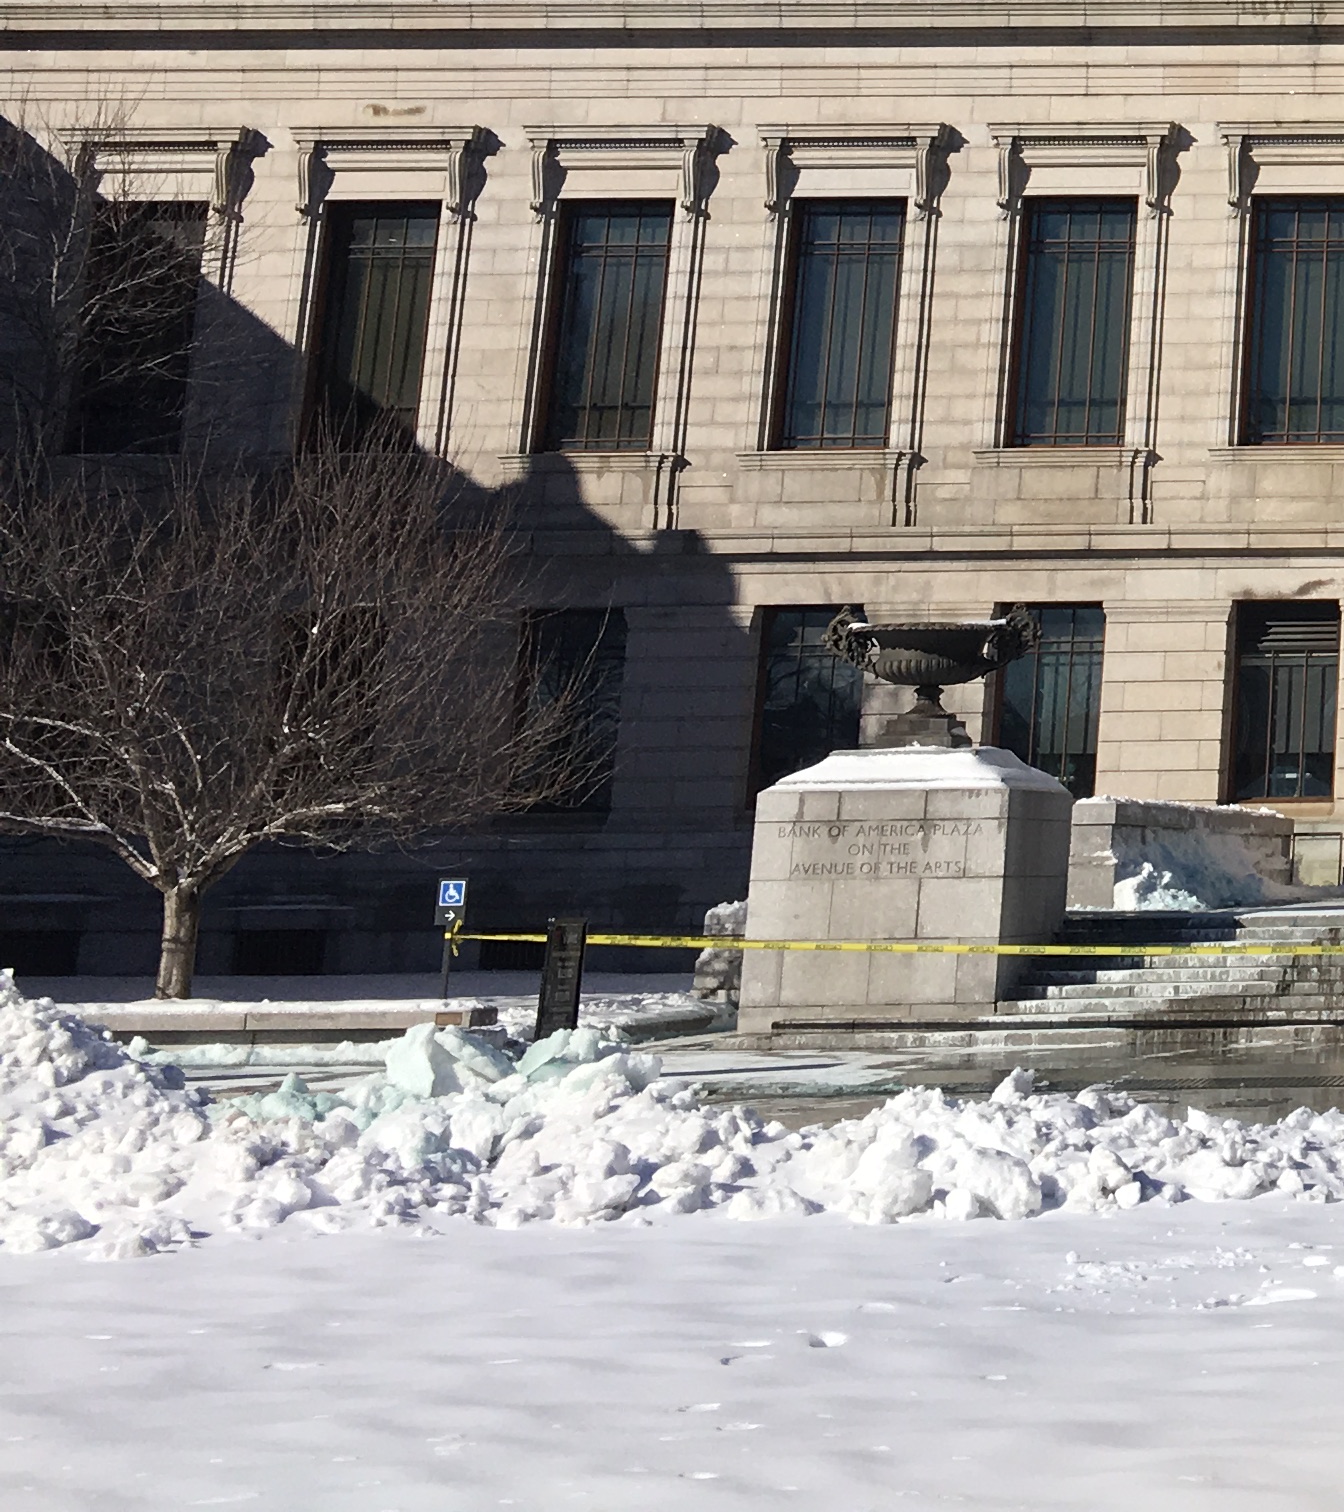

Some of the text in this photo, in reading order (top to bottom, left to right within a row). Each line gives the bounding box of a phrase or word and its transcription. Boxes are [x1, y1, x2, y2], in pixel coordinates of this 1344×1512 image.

[778, 823, 984, 838] BANK OF AMERICA PLAZA
[847, 842, 910, 856] ON THE
[792, 862, 857, 876] AVENUE
[859, 862, 880, 875] OF
[887, 861, 918, 874] THE
